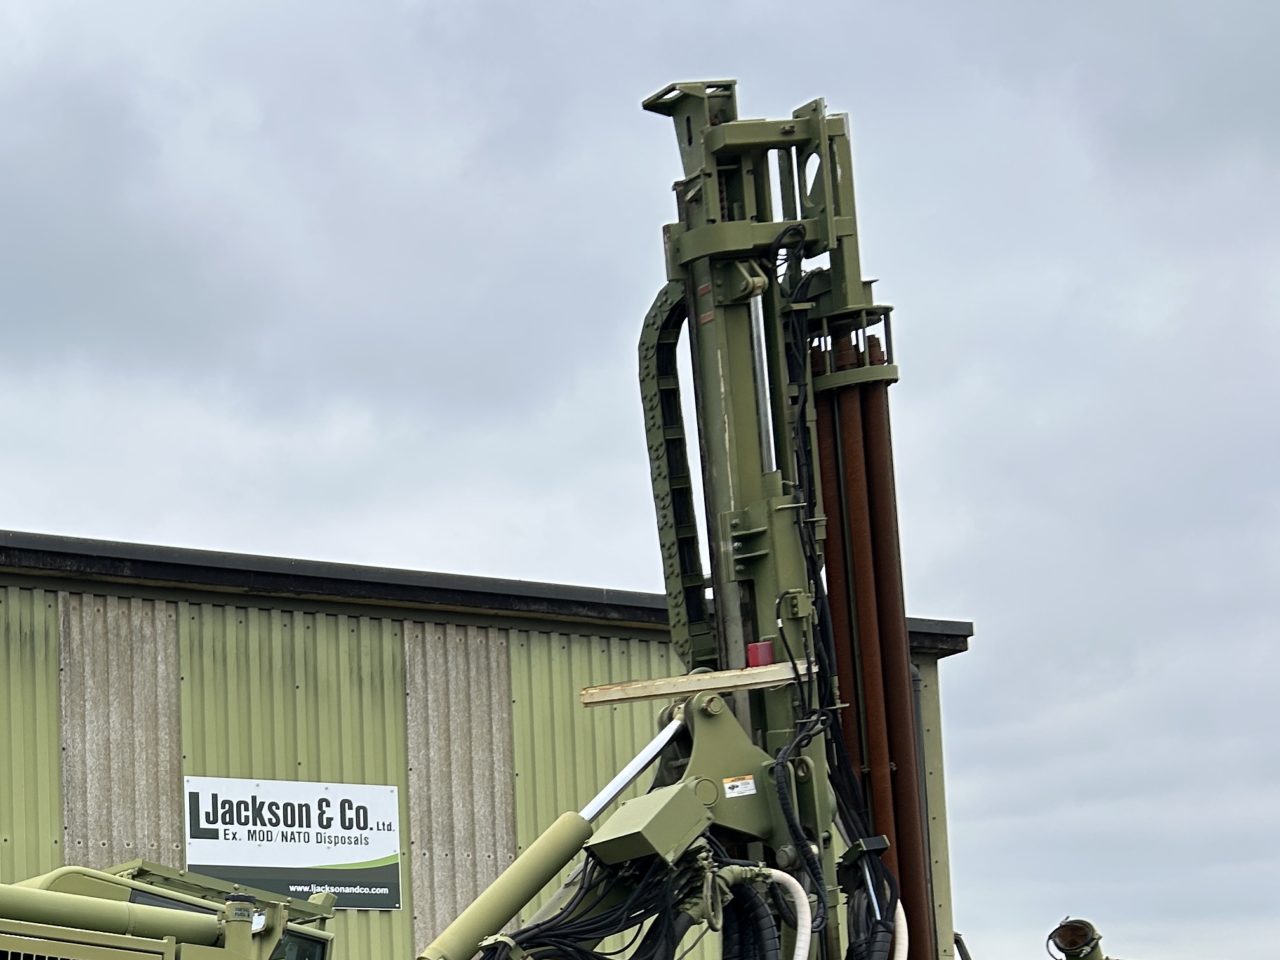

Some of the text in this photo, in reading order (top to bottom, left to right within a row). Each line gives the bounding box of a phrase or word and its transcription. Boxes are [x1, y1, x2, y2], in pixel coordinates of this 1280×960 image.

[317, 797, 334, 829] &
[340, 798, 374, 831] Co.
[376, 821, 395, 832] Ltd.
[223, 829, 369, 847] Ex. MOD/NATO Disposals
[289, 884, 389, 895] www.ljacksonandco.com
